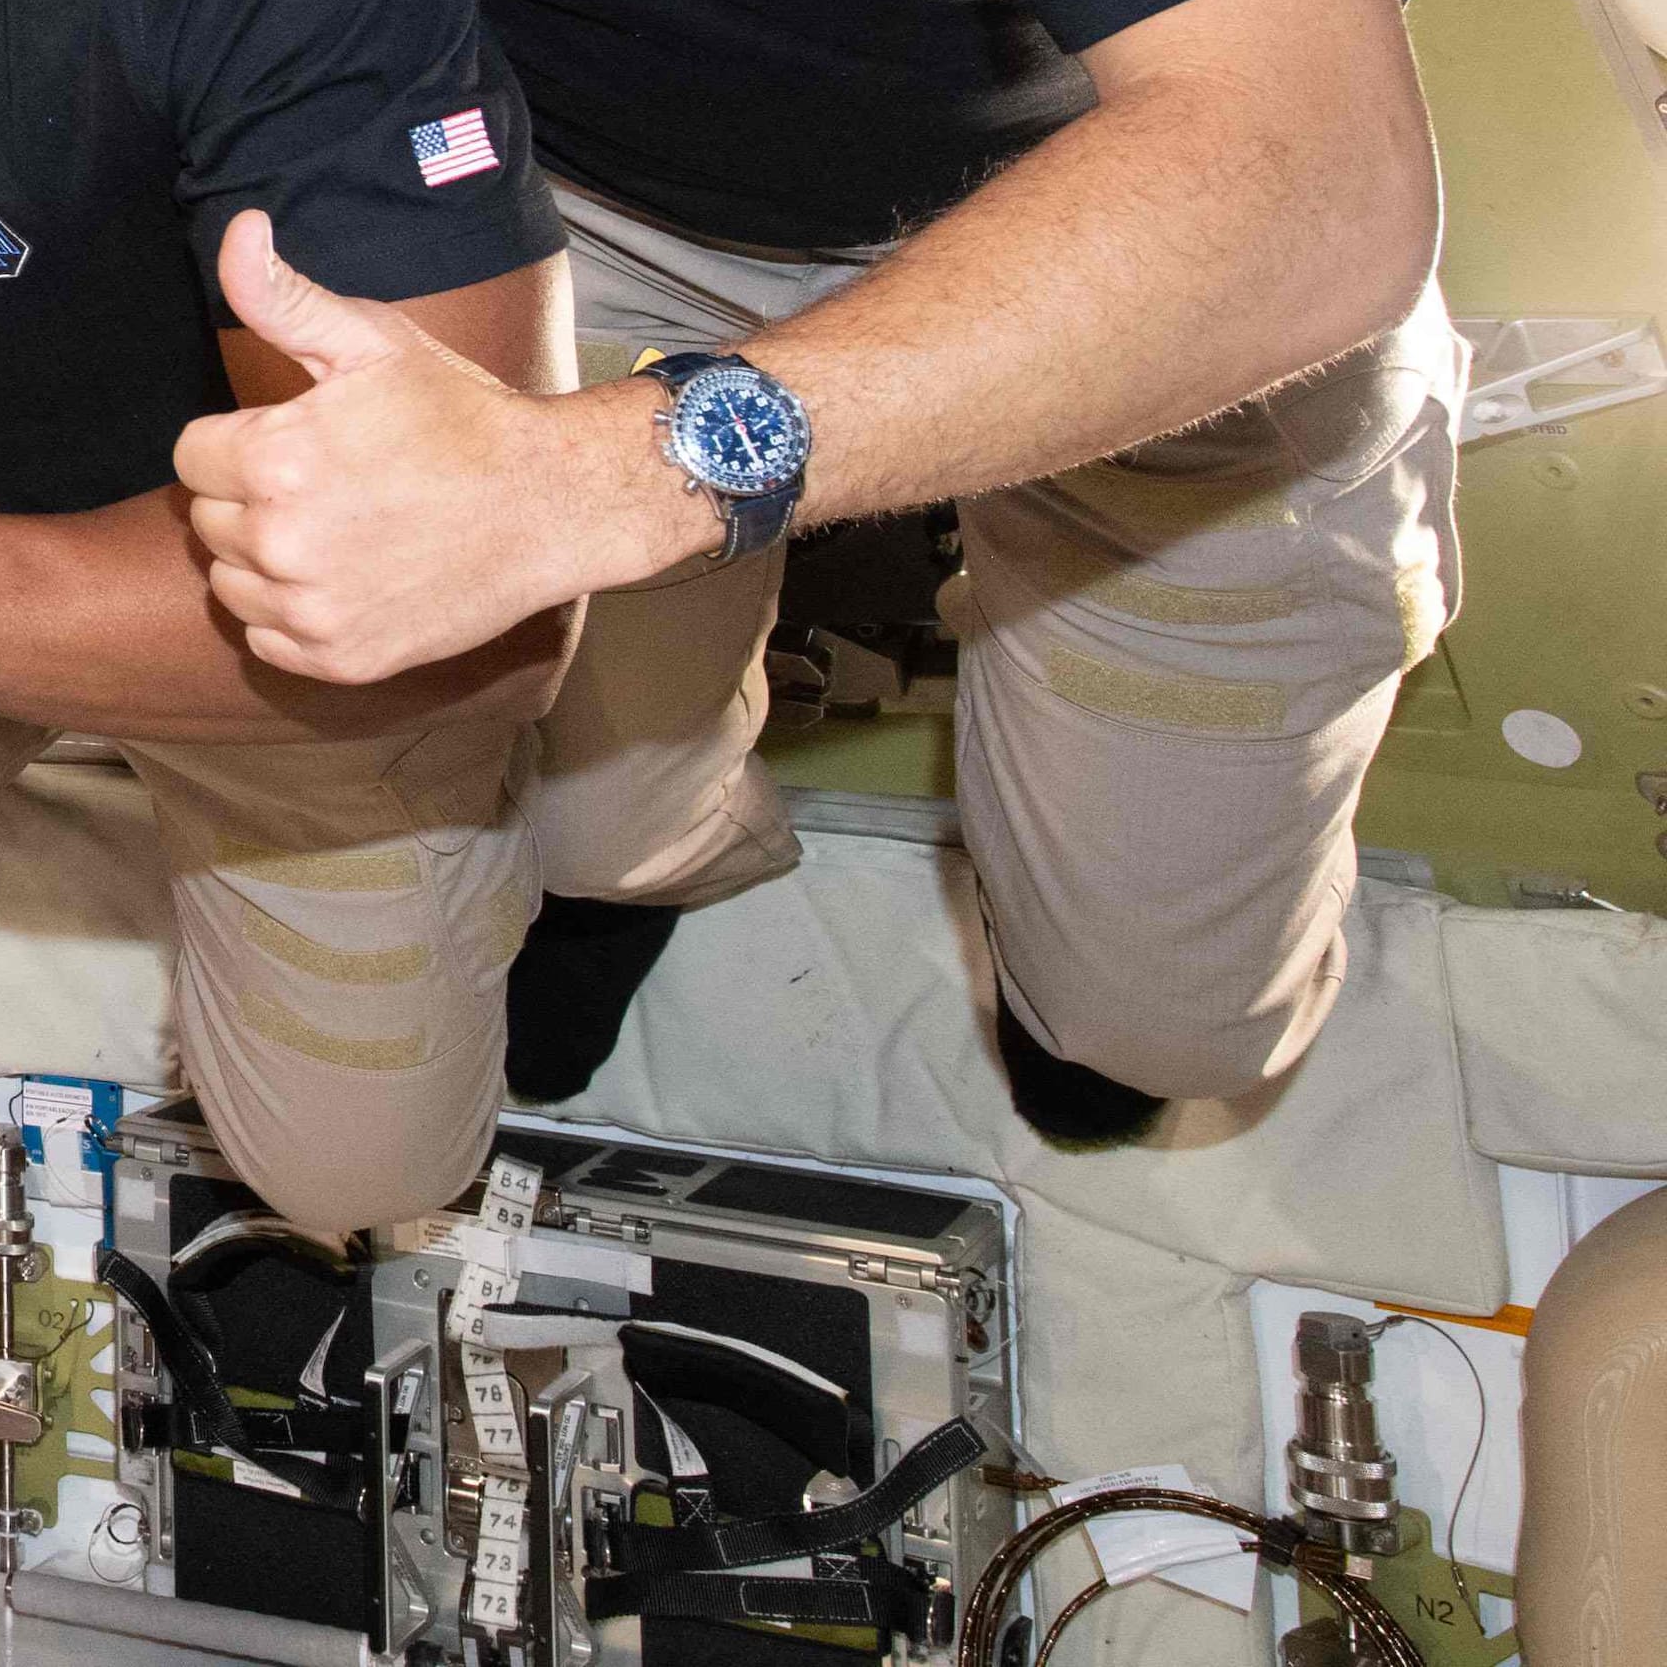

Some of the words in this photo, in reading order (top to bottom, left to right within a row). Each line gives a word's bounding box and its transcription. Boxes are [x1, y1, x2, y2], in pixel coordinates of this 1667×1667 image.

[500, 1172, 530, 1192] 84
[497, 1207, 524, 1228] 83
[481, 1280, 503, 1301] 81
[474, 1384, 503, 1403] 78
[483, 1428, 513, 1445] 77
[490, 1513, 517, 1529] 74
[484, 1554, 511, 1572] 73
[480, 1594, 507, 1614] 72
[1415, 1594, 1456, 1626] N2
